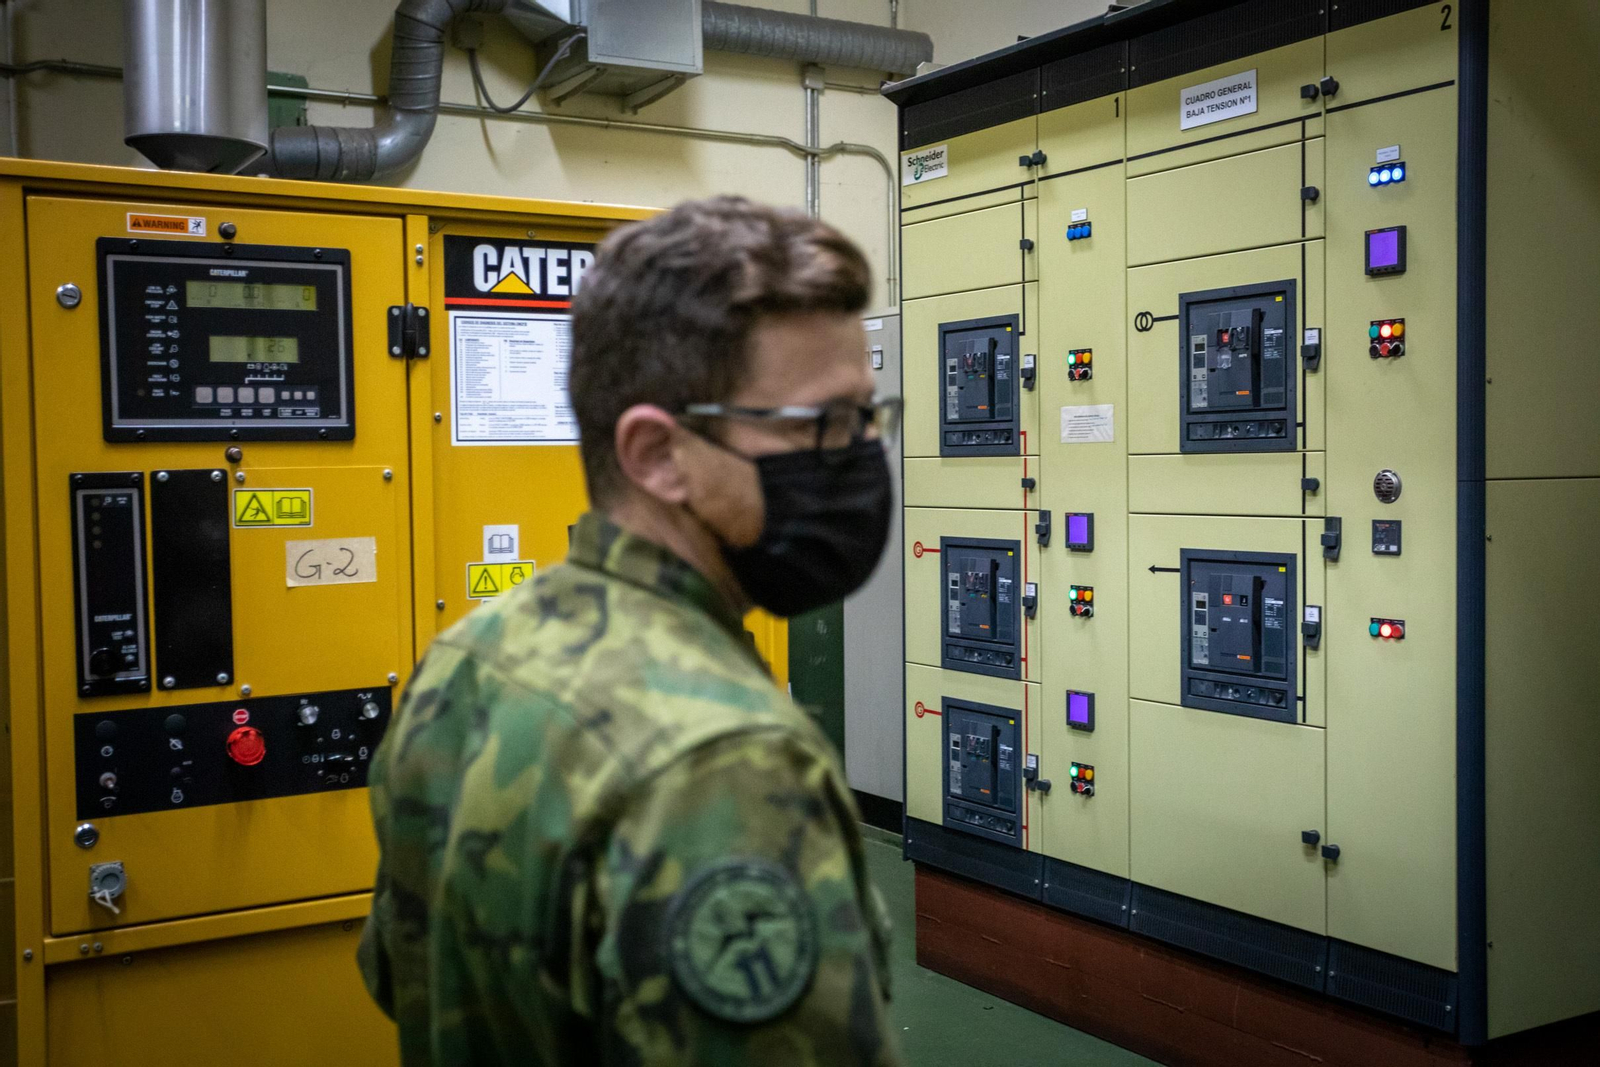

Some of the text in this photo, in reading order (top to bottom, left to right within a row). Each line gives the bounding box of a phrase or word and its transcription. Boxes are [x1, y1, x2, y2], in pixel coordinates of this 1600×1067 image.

[1441, 4, 1452, 31] 2
[1185, 81, 1253, 106] CUADRO GENERAL
[1114, 96, 1120, 118] 1
[1186, 107, 1205, 119] BAJA
[1206, 98, 1238, 113] TENSION
[907, 150, 944, 168] Schneider
[924, 162, 944, 174] Electric
[142, 218, 186, 231] WARNING
[294, 547, 359, 580] G-2
